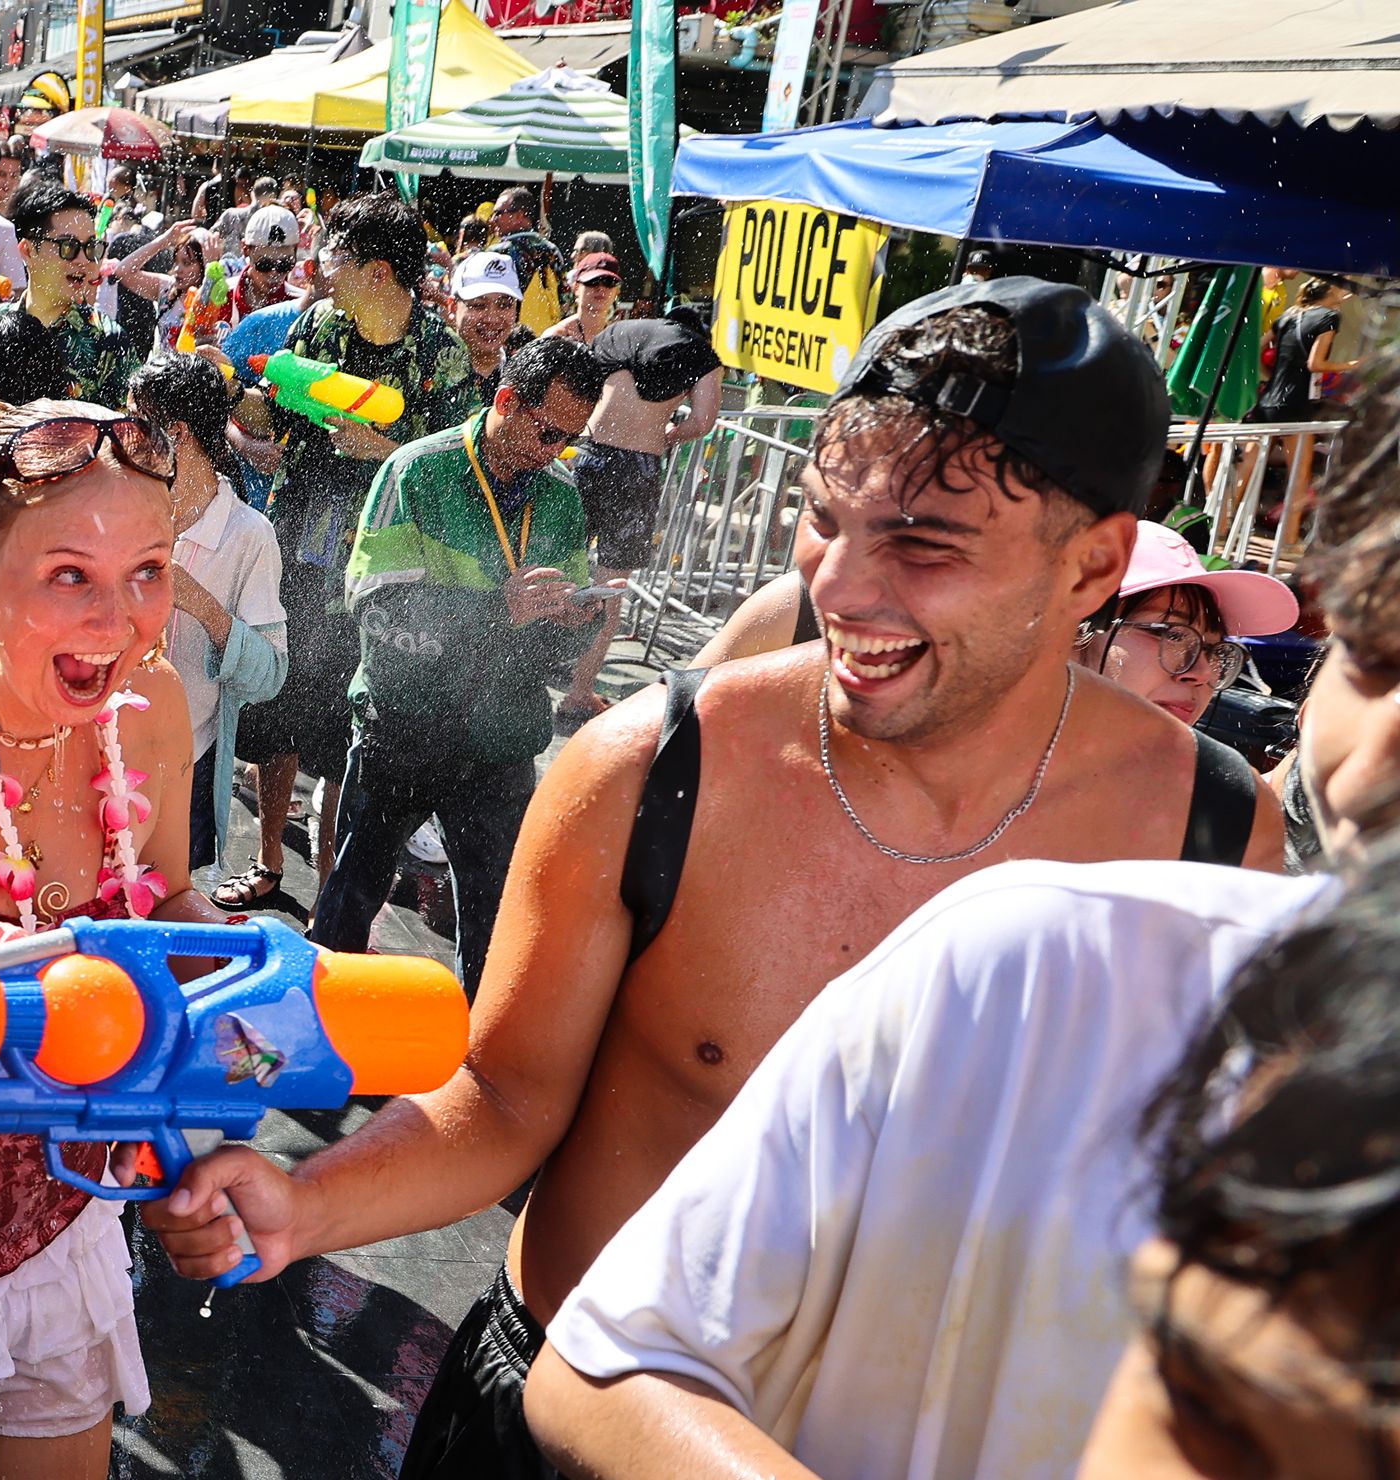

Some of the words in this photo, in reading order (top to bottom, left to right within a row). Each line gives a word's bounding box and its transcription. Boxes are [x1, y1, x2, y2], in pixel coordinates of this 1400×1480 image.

[409, 147, 446, 158] BUDDY
[448, 149, 479, 161] BEER
[736, 208, 857, 320] POLICE
[741, 320, 827, 372] PRESENT
